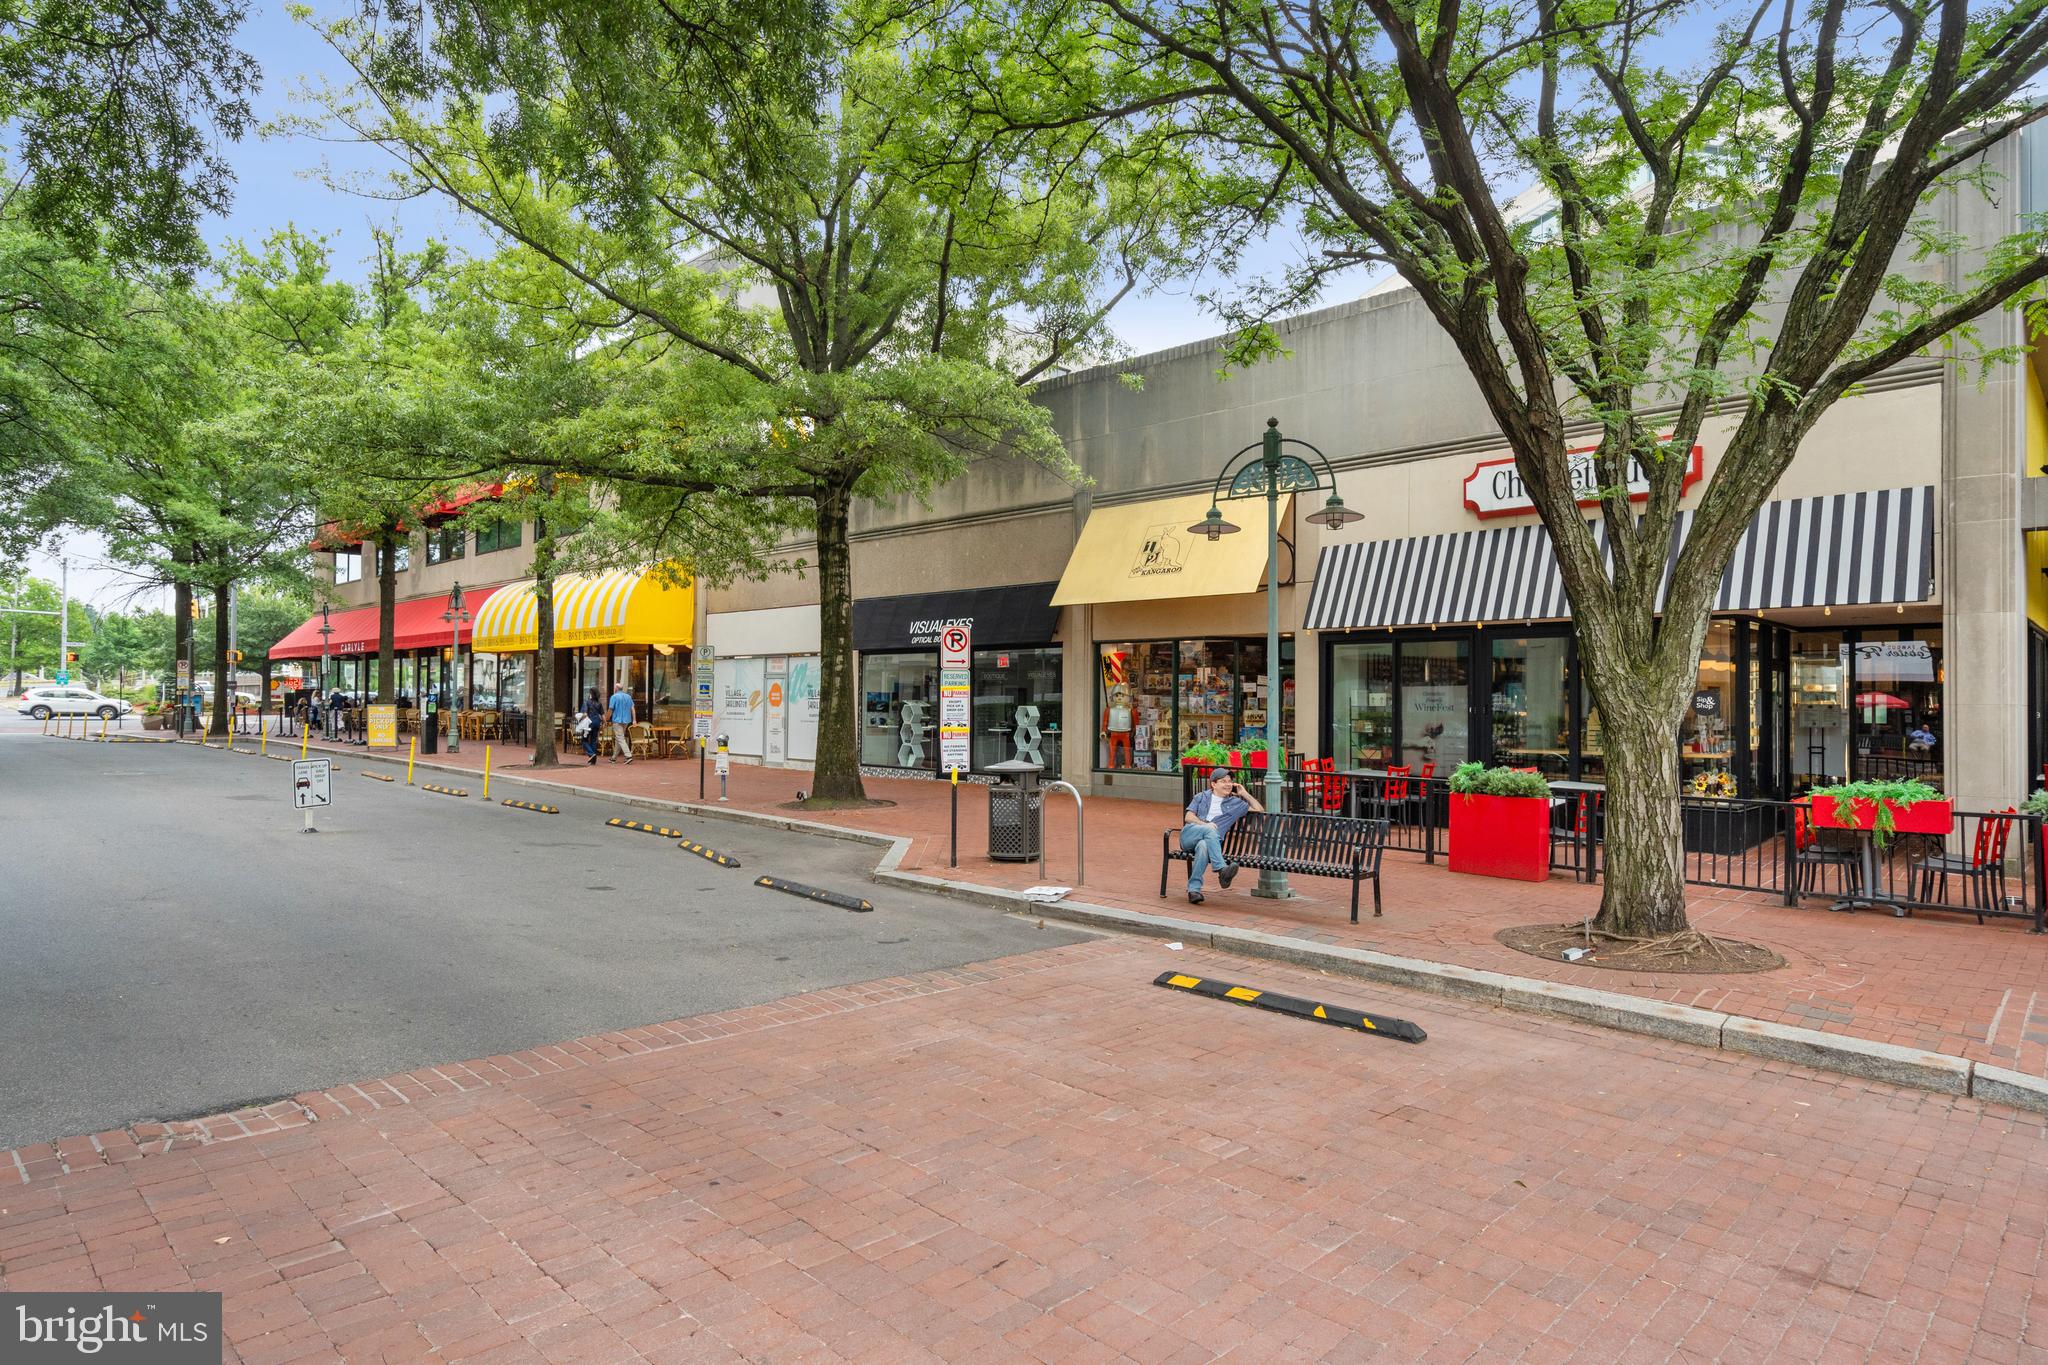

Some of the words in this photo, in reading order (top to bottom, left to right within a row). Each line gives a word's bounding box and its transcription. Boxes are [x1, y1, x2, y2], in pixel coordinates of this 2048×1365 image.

[911, 636, 933, 644] OPTICAL
[340, 641, 365, 653] CARLYLE
[1415, 703, 1455, 712] WineFest
[1696, 702, 1714, 710] Shop
